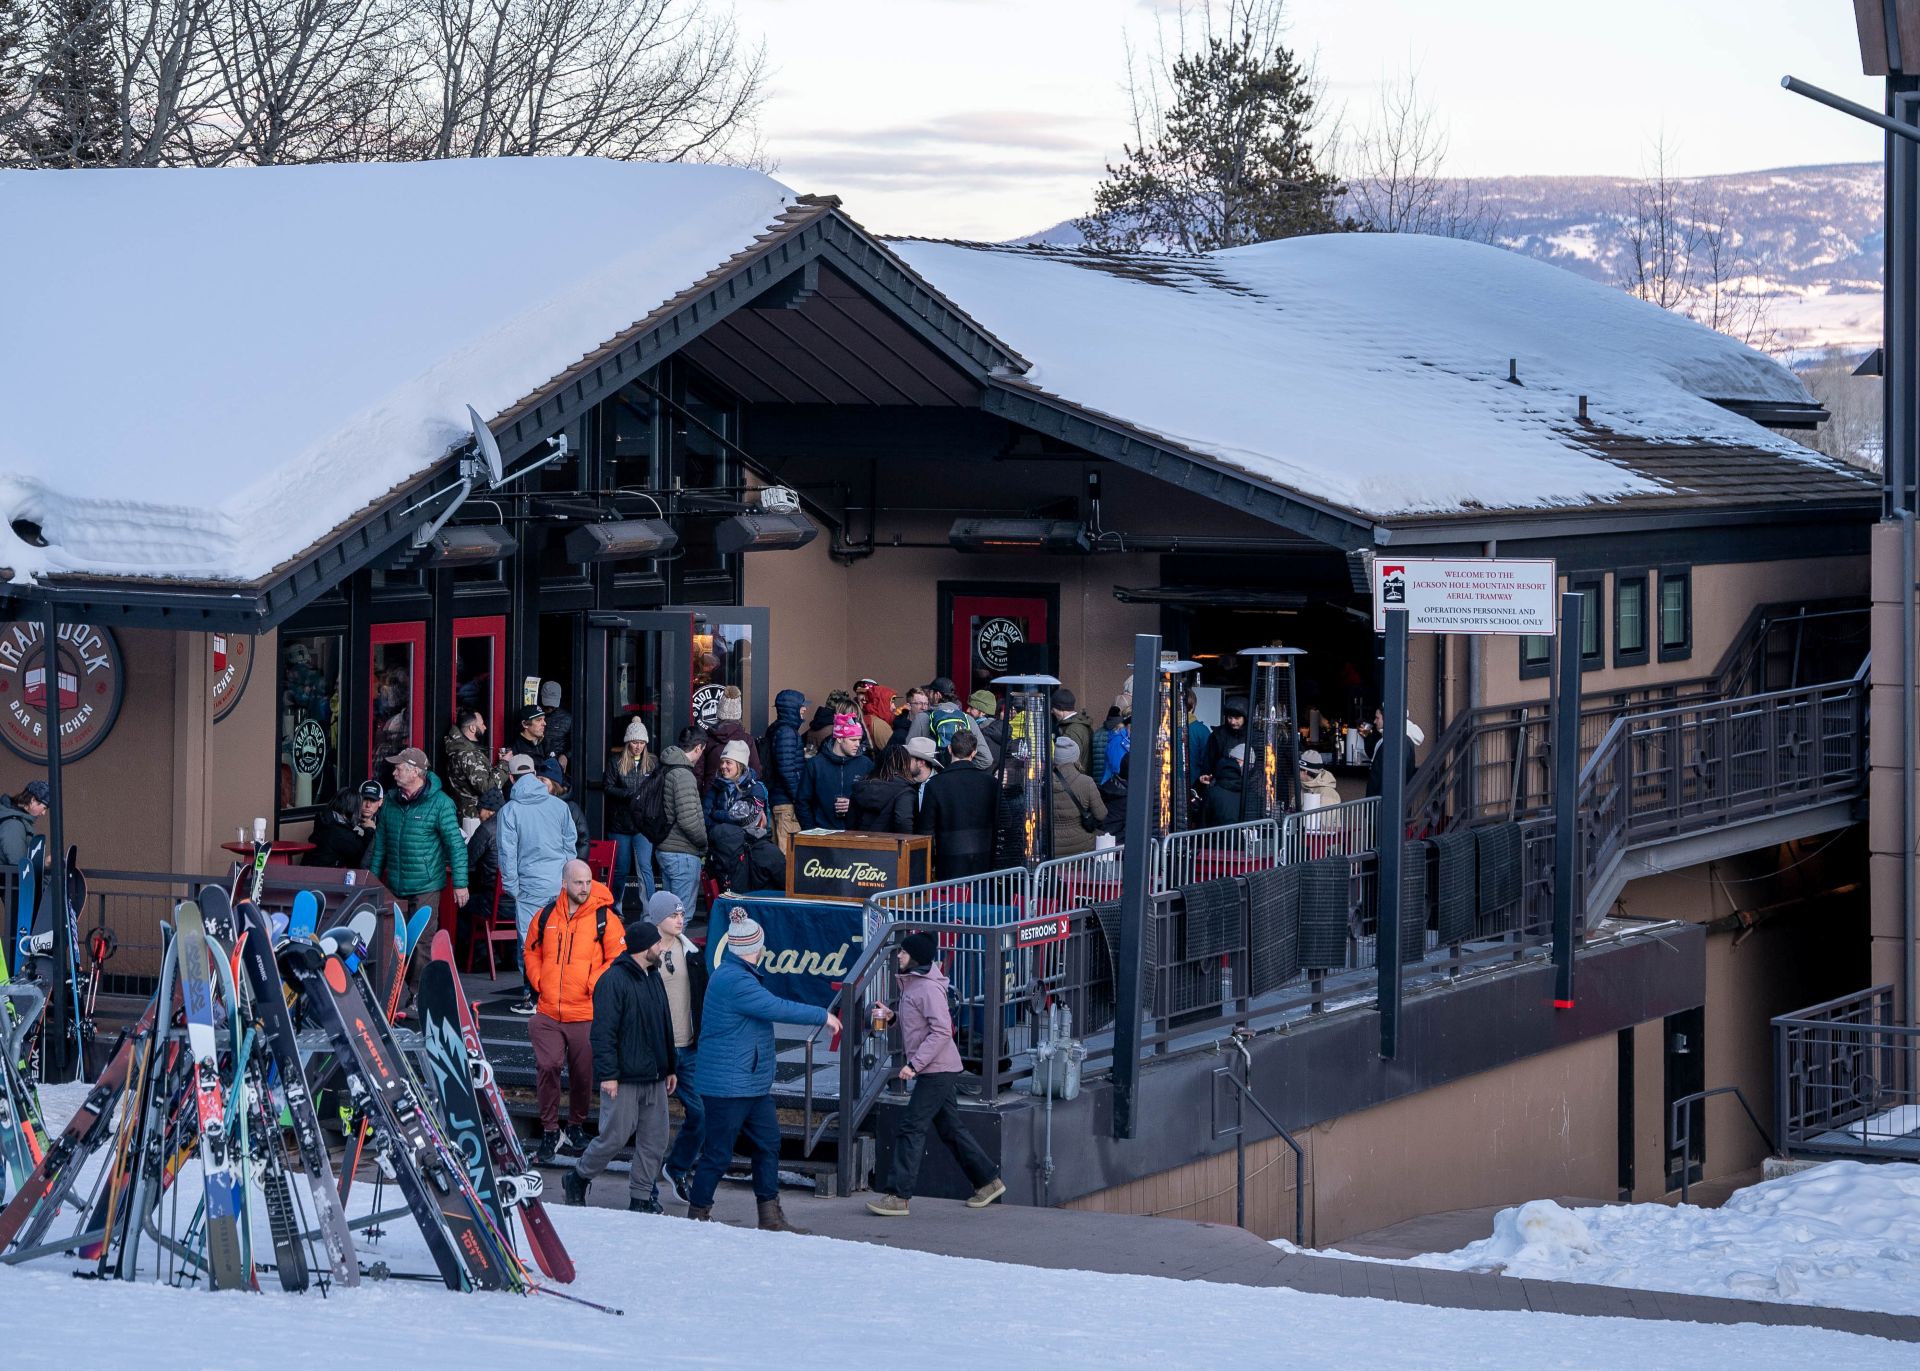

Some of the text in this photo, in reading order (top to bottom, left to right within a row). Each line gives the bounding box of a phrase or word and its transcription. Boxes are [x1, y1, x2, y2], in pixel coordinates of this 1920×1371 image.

[1412, 581, 1447, 589] JACKSON
[1449, 581, 1471, 589] HOLE
[1472, 582, 1515, 590] MOUNTAIN
[1417, 616, 1459, 624] MOUNTAIN
[1424, 606, 1471, 614] OPERATIONS
[981, 622, 1021, 643] TRAM DOCK
[213, 664, 236, 697] TCHEN
[9, 700, 31, 727] BAR
[33, 722, 42, 736] &
[60, 703, 93, 736] TCHEN
[295, 724, 324, 749] TRAM DOCK
[803, 858, 888, 882] Grand Teton
[1020, 922, 1057, 941] RESTROOMS
[255, 954, 268, 982] ATOMIC
[31, 1048, 40, 1079] EAK
